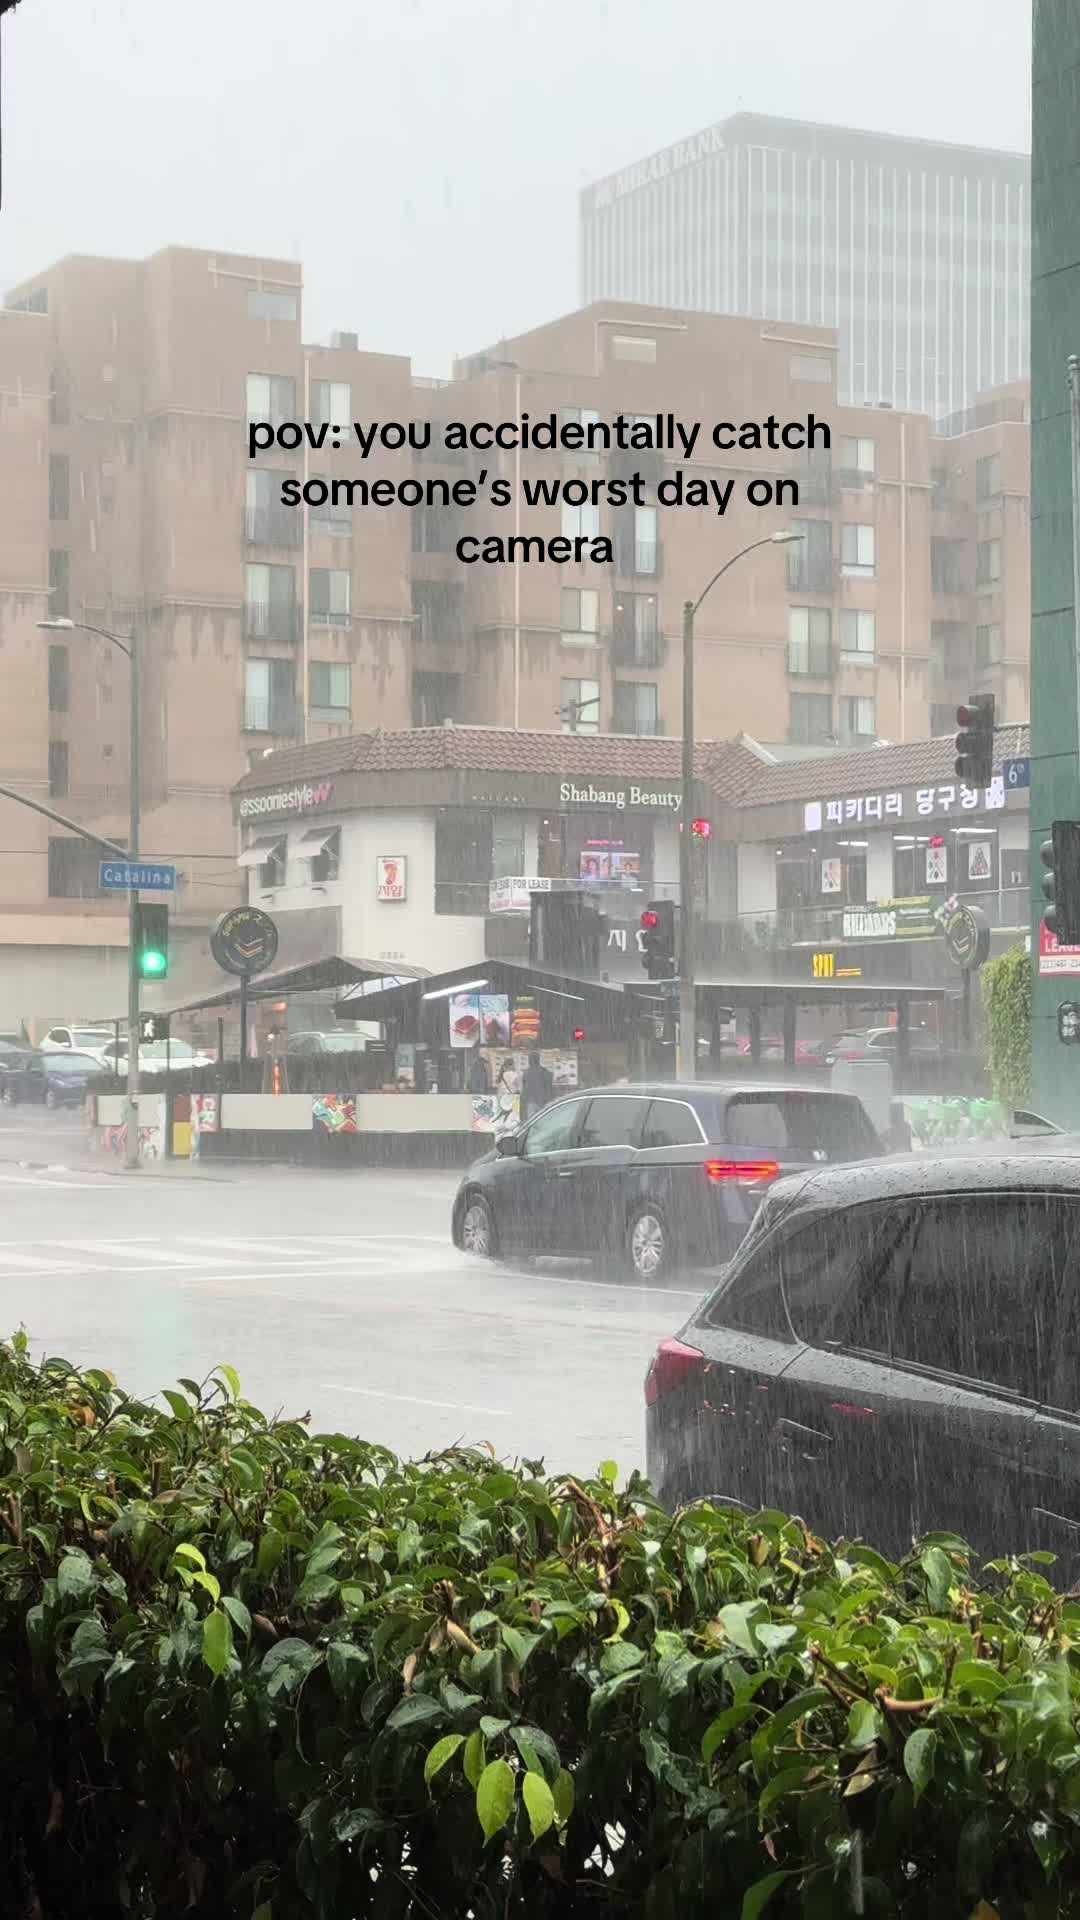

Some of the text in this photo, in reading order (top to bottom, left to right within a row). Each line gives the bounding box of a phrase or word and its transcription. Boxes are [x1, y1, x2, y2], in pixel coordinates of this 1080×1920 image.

[560, 783, 682, 811] Shabang Beauty
[103, 868, 171, 885] Catalina
[512, 878, 528, 889] FOR
[529, 879, 550, 890] LEASE
